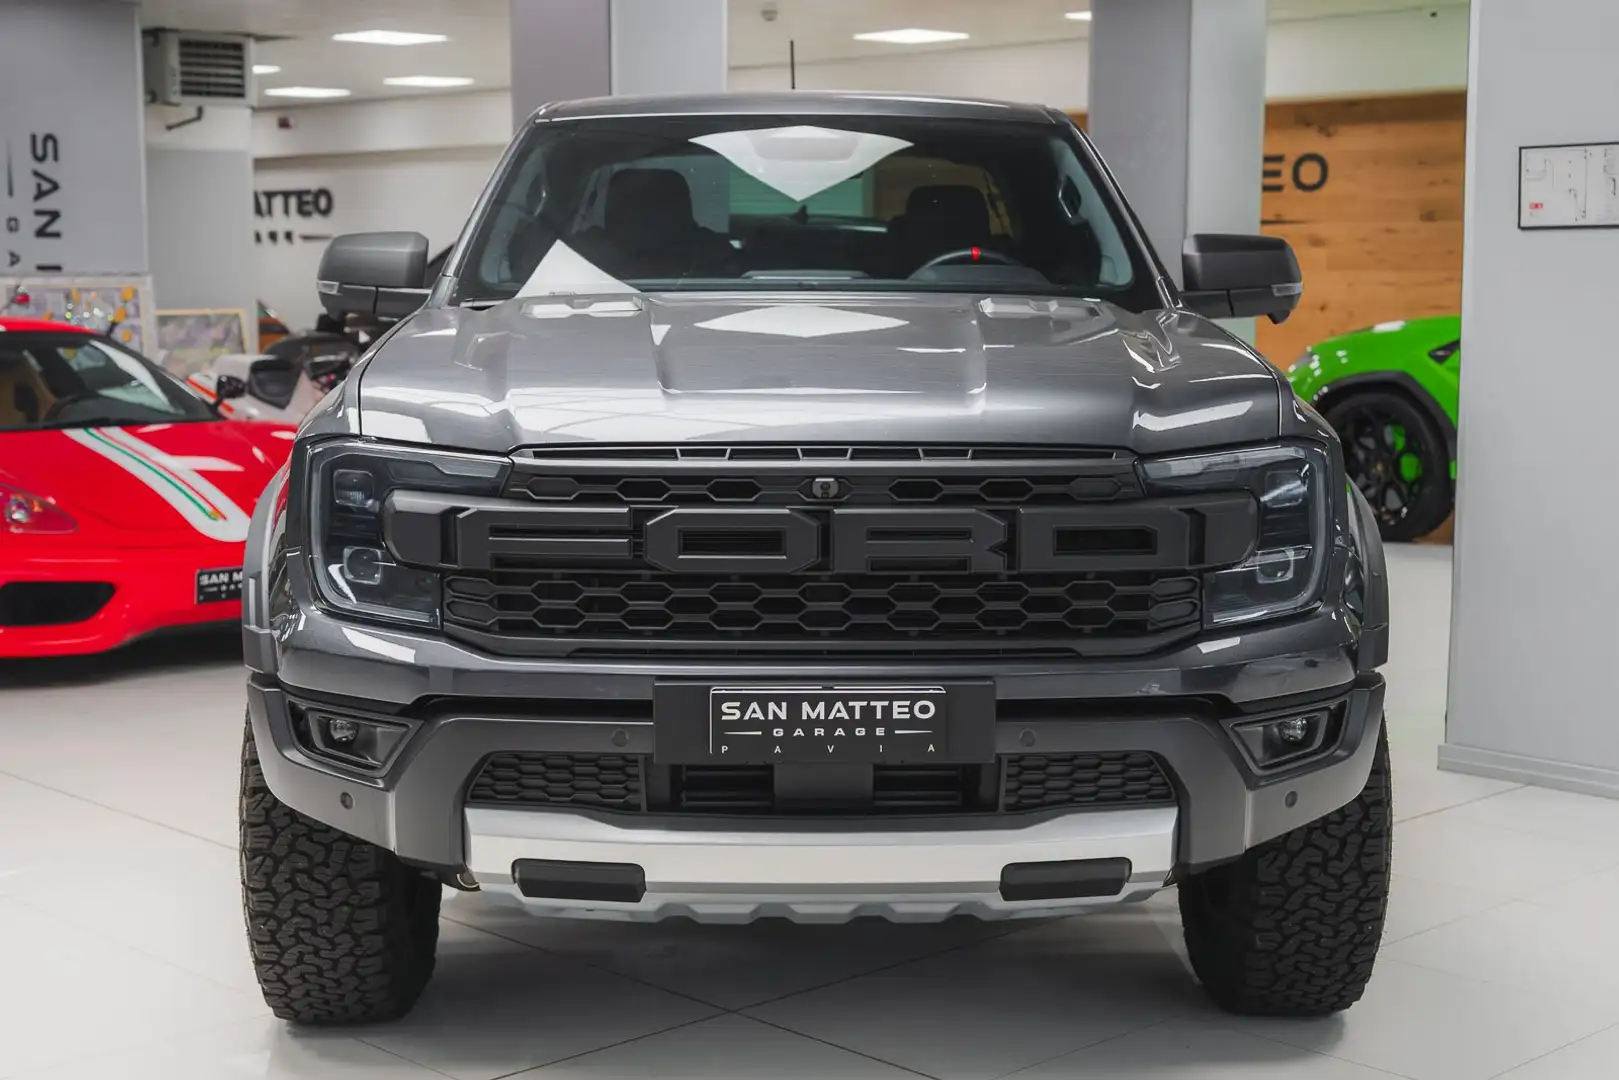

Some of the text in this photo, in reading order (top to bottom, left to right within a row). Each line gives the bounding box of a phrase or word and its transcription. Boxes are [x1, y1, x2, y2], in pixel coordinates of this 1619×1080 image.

[30, 132, 62, 239] SAN
[456, 505, 1191, 574] FORD
[200, 572, 229, 585] SAN
[720, 700, 936, 721] SAN MATTEO
[772, 727, 886, 737] GARAGE
[721, 744, 936, 754] PAVIA
